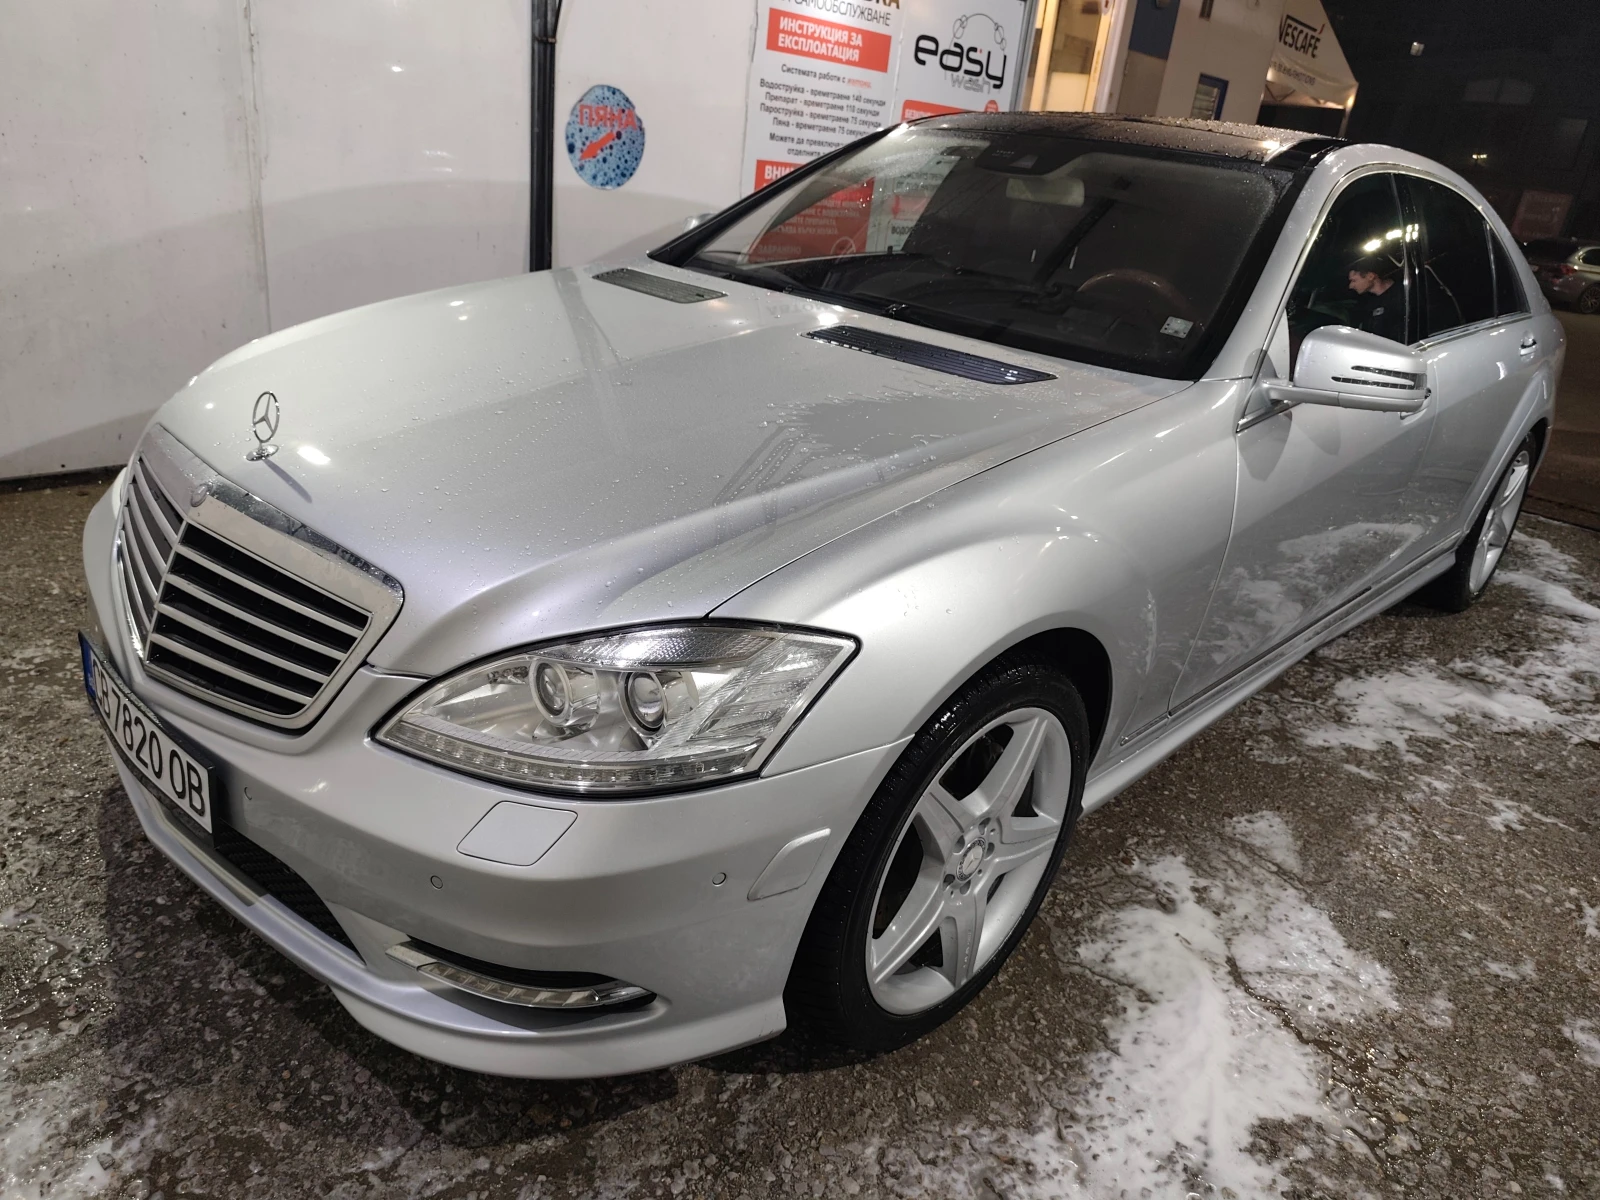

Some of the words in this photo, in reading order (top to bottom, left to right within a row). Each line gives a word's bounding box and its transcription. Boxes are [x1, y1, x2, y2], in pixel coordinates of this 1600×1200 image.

[779, 16, 849, 45] ИНСТРУКЦИЯ
[850, 33, 862, 47] ЗА
[778, 34, 860, 62] ЕКСПЛОАТАЦИЯ
[781, 63, 817, 79] Системата
[818, 72, 841, 83] работи
[842, 76, 846, 84] с
[914, 34, 1007, 89] easy
[760, 78, 805, 94] Водоструйка
[810, 88, 851, 101] времетраене
[863, 97, 886, 107] секунди
[950, 73, 991, 95] wash
[760, 102, 804, 118] Пароструйка
[809, 111, 850, 124] времетраене
[850, 116, 858, 125] 75
[765, 91, 798, 105] Препарат
[803, 99, 844, 112] времетраене
[856, 107, 880, 117] секунди
[579, 104, 638, 131] ПЯНА
[772, 117, 790, 128] Пяна
[795, 121, 837, 133] времетраене
[838, 125, 845, 135] 75
[769, 132, 795, 144] Можете
[796, 137, 805, 145] да
[111, 686, 163, 780] 7820
[169, 749, 206, 818] OB
